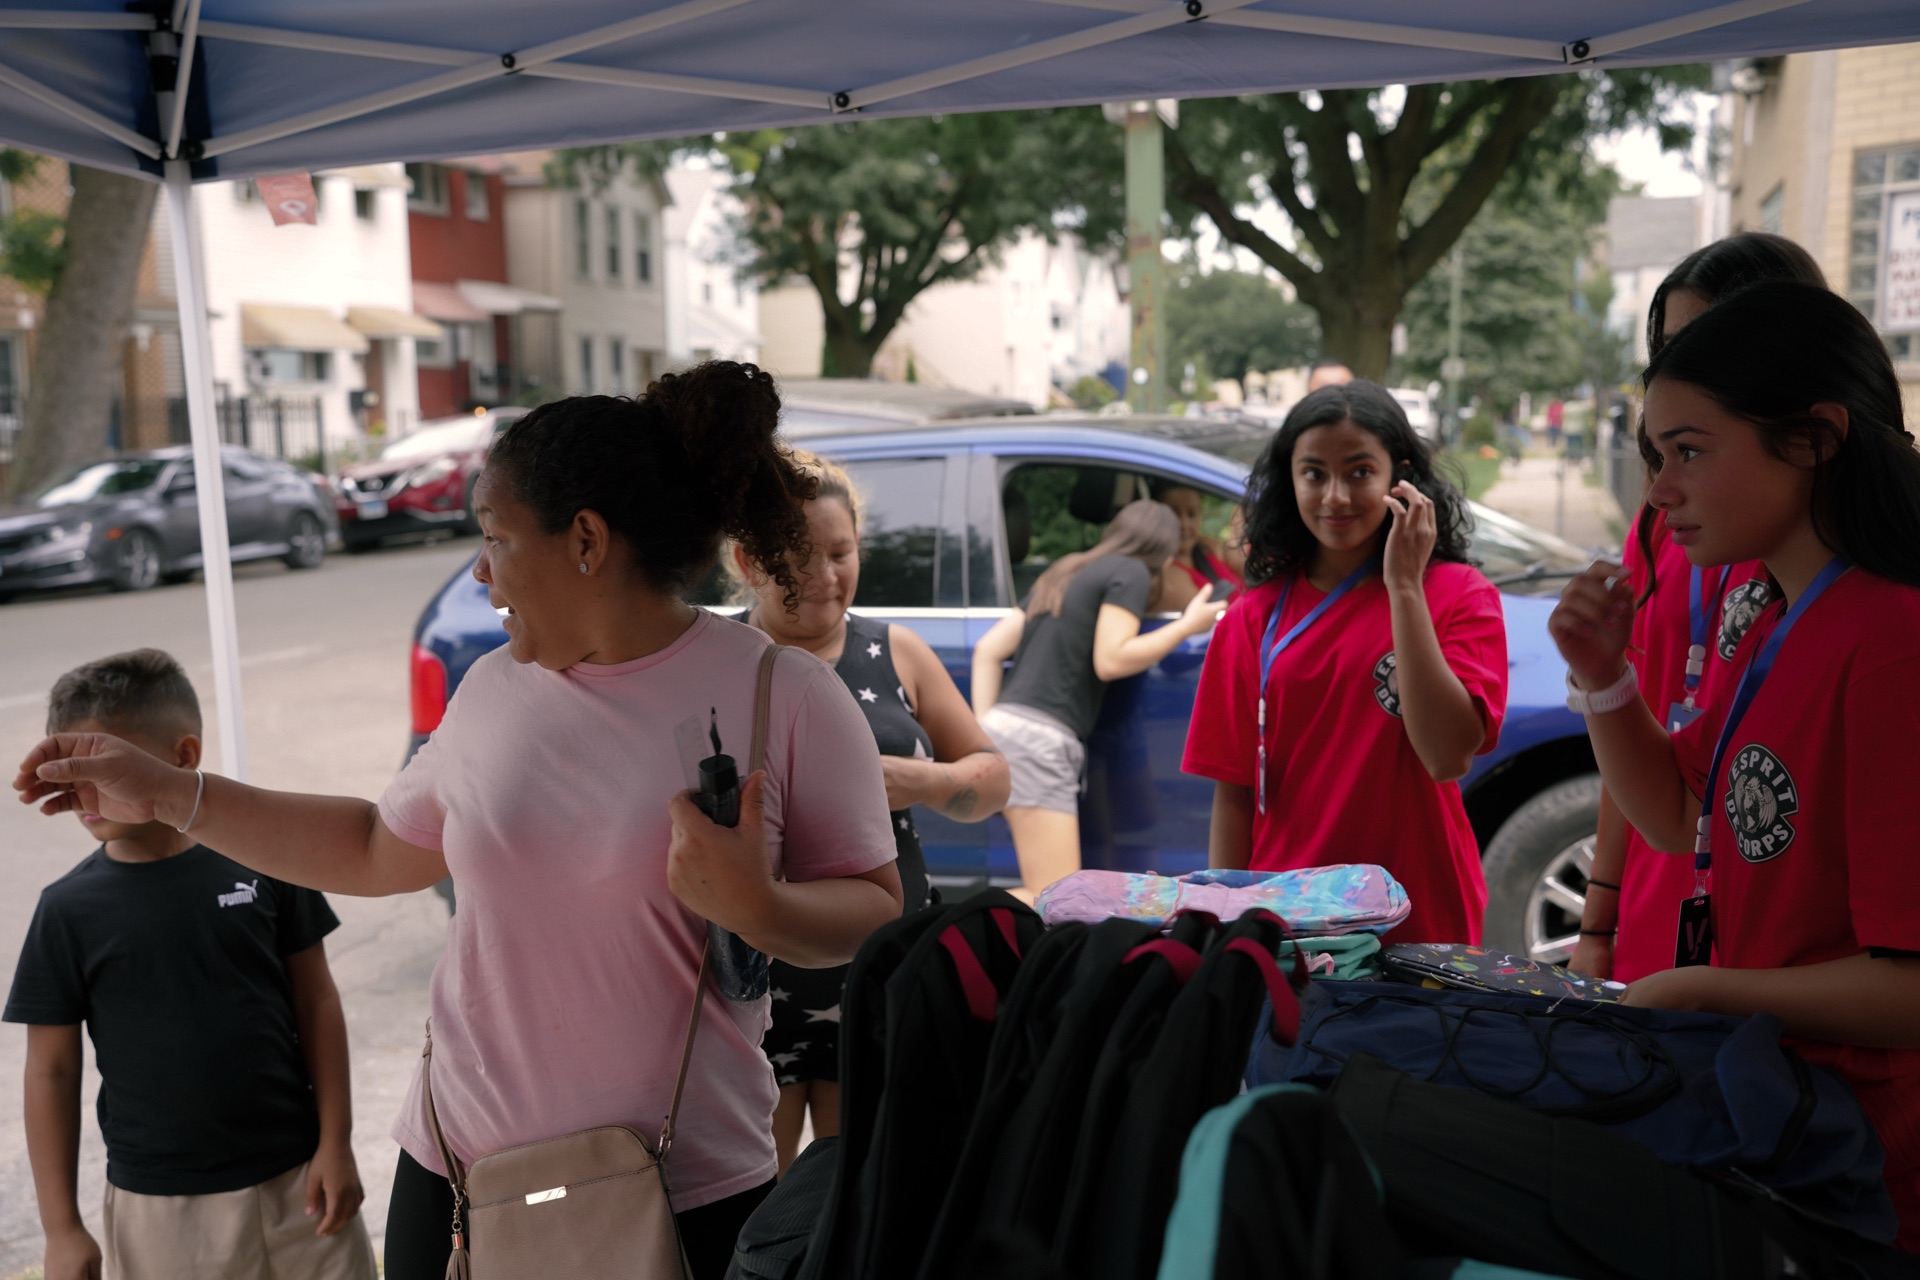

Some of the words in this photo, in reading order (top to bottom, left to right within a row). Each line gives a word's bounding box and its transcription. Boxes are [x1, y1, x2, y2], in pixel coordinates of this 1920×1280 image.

[1378, 687, 1396, 709] DE
[1731, 750, 1795, 803] ESPRIT
[1726, 798, 1740, 832] DE
[1738, 824, 1789, 857] CORPS
[217, 890, 254, 908] PUMA
